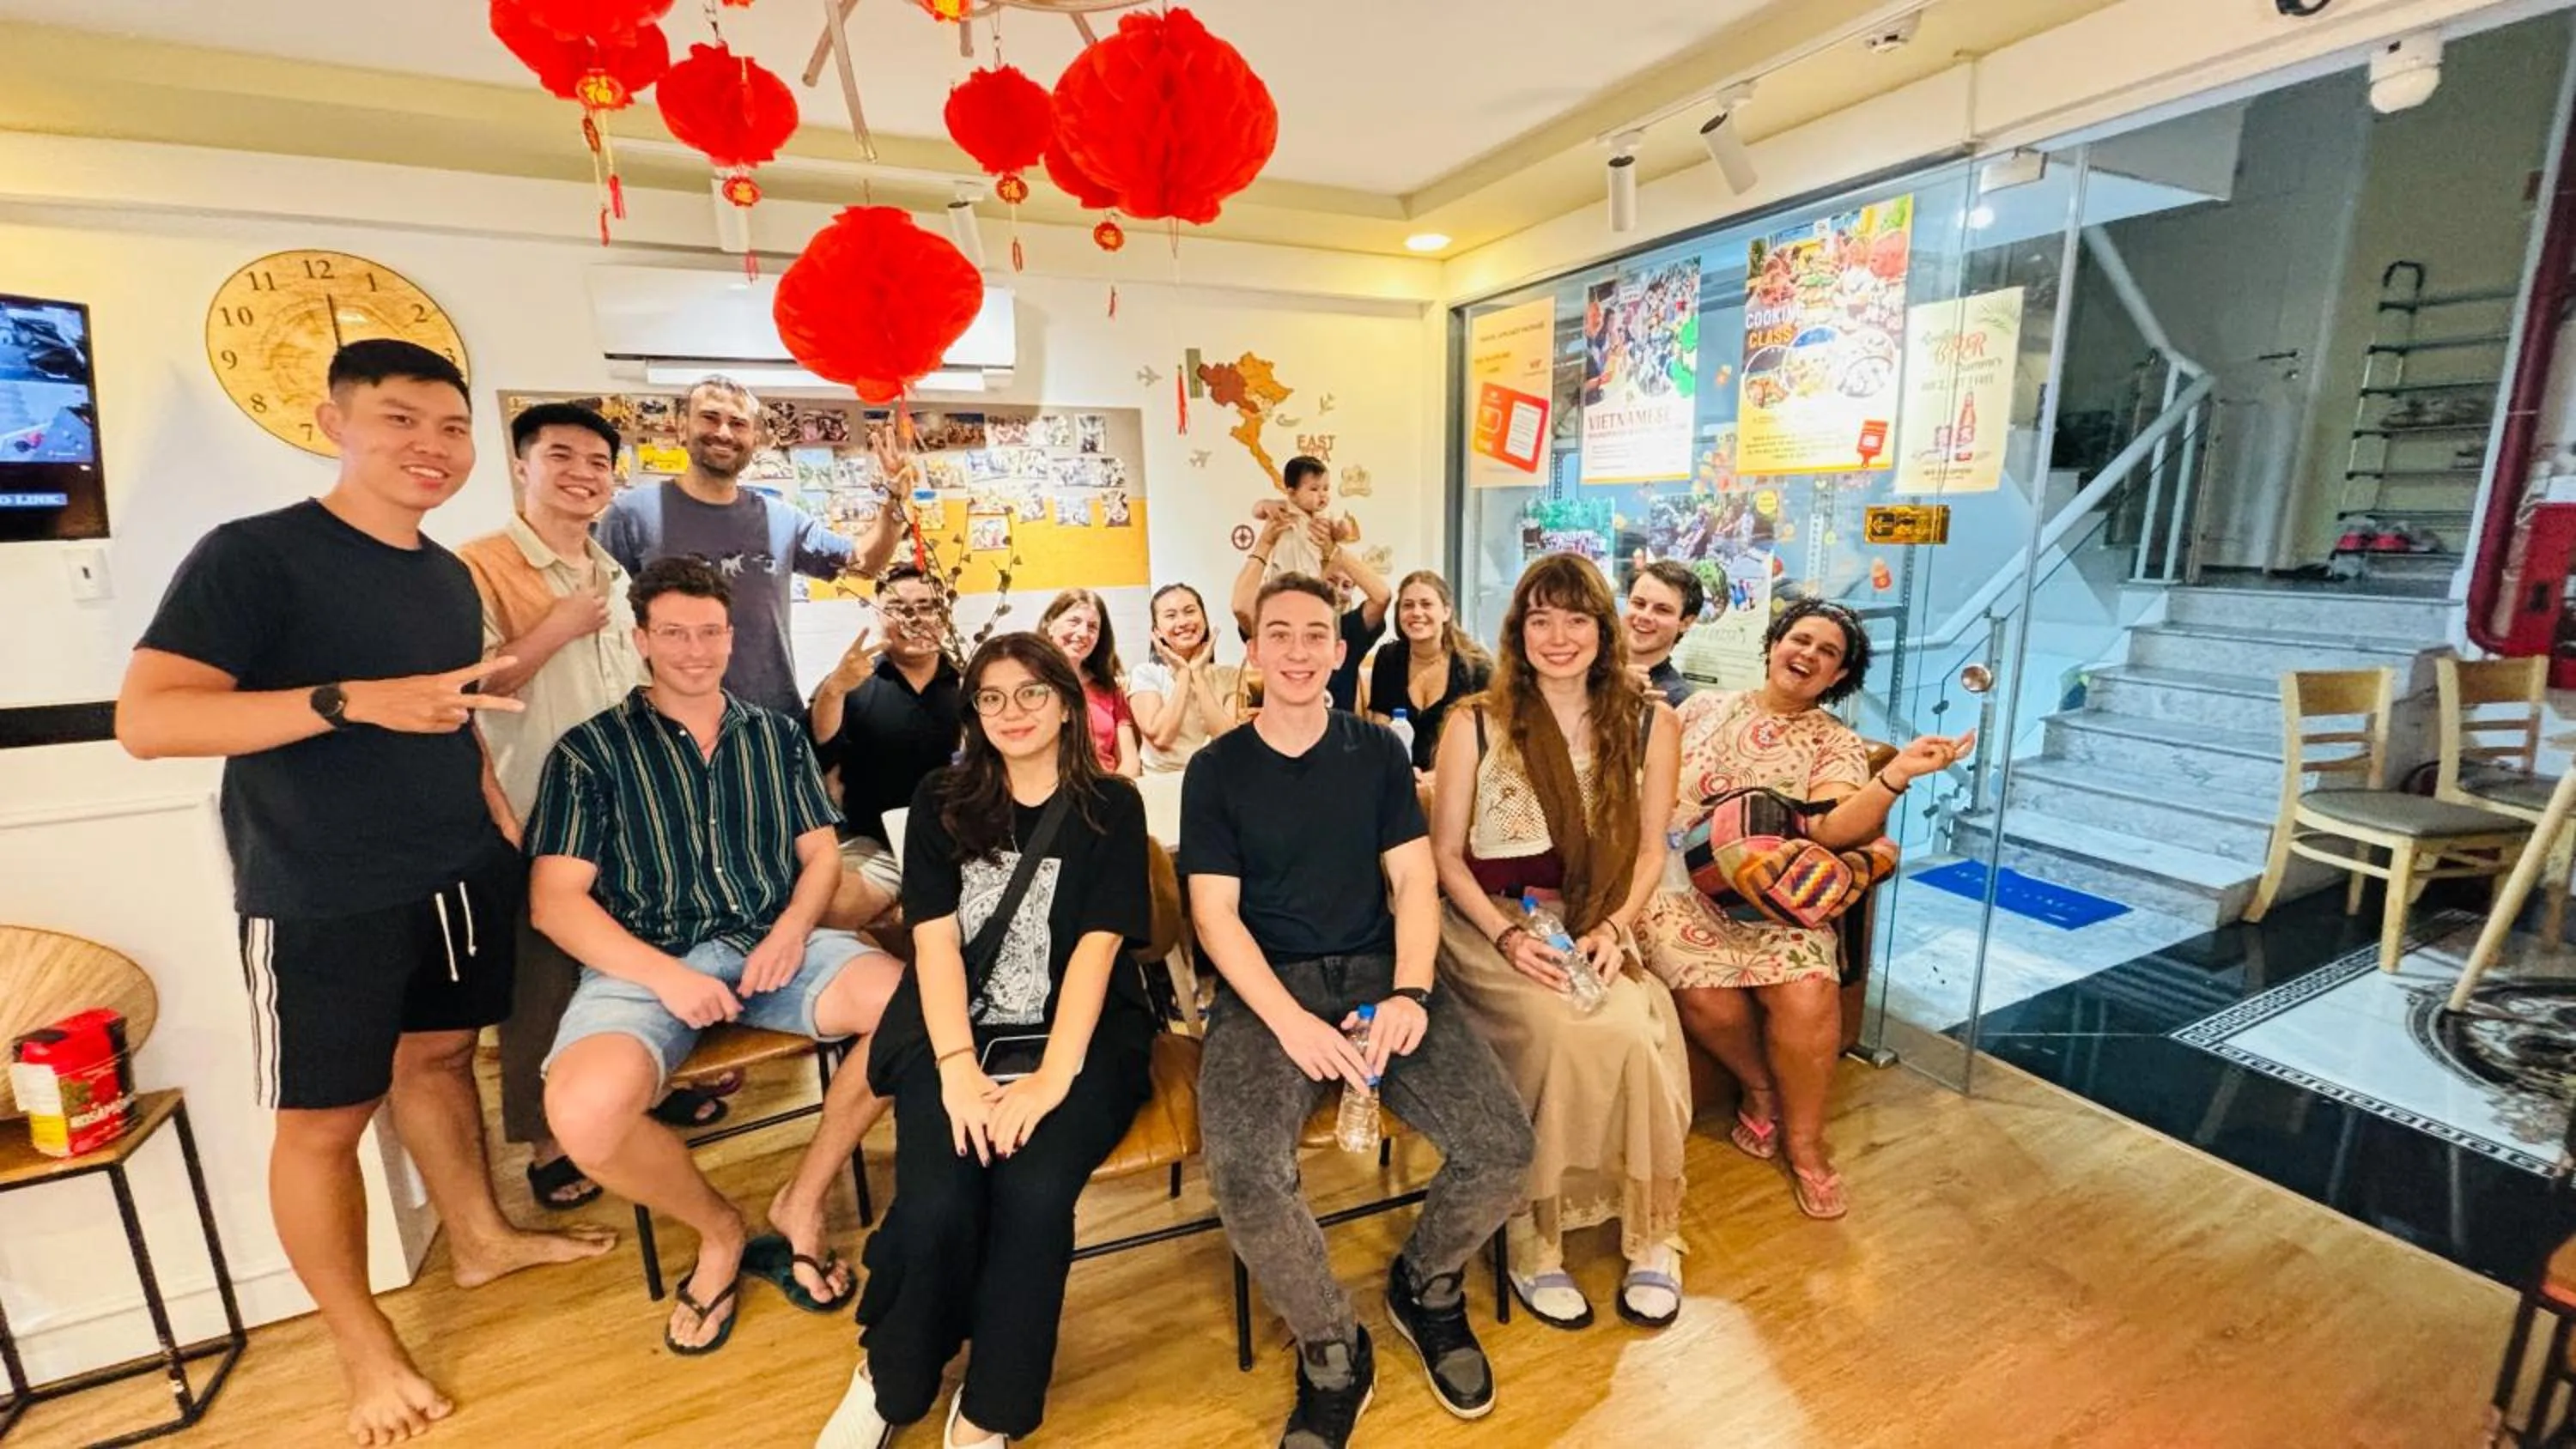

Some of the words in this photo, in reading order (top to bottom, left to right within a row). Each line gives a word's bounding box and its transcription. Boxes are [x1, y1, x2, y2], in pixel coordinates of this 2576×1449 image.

[301, 259, 335, 279] 12
[245, 270, 277, 291] 11
[366, 272, 377, 292] 1
[219, 306, 254, 327] 10
[410, 303, 428, 323] 2
[1748, 325, 1794, 349] CLASS
[221, 349, 238, 370] 9
[444, 347, 457, 365] 3
[250, 392, 268, 413] 8
[298, 422, 313, 442] 7
[1297, 433, 1336, 451] EAST
